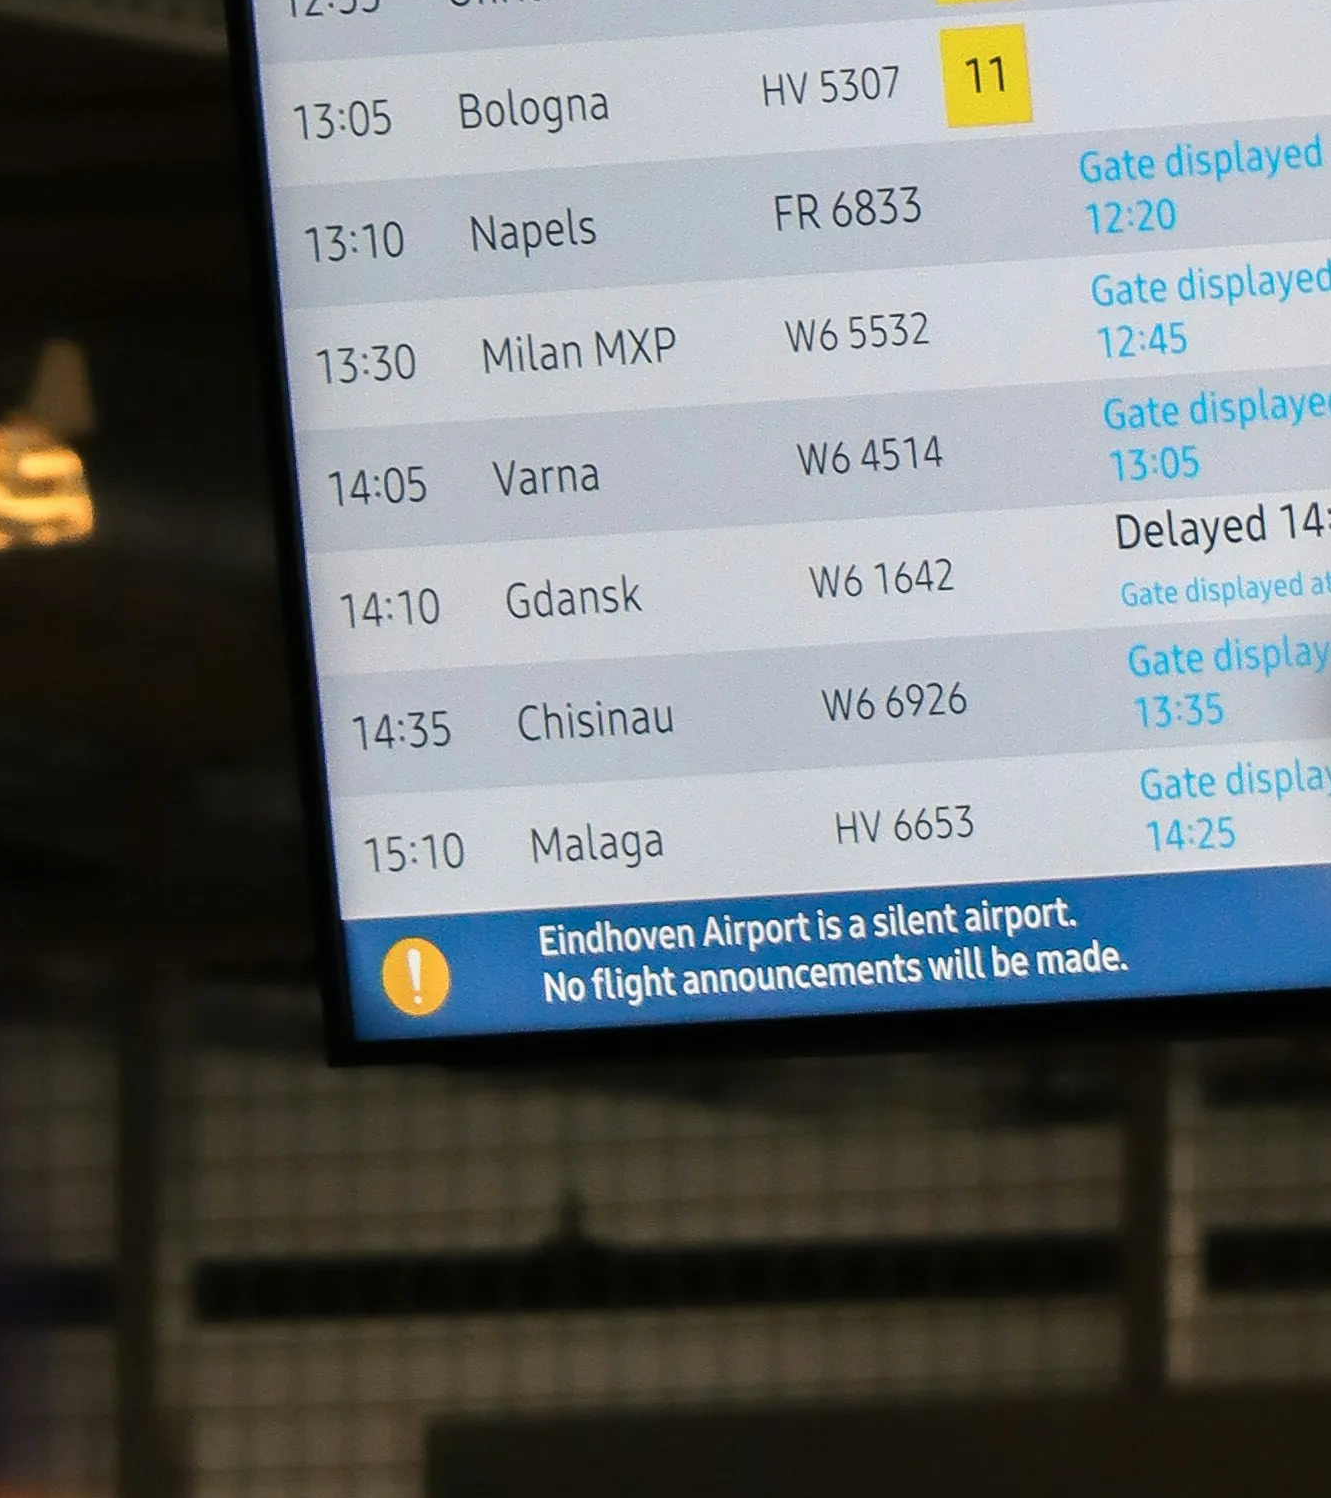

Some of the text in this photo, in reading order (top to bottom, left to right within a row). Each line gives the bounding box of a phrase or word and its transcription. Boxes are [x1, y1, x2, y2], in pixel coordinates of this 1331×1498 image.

[761, 64, 900, 108] HV 5307
[964, 54, 1006, 95] 11
[292, 97, 393, 141] 13:05
[457, 87, 610, 135] Bologna
[1078, 148, 1157, 185] Gate
[1164, 131, 1325, 184] displayed
[773, 184, 923, 233] FR 6833
[1084, 195, 1179, 236] 12:20
[303, 219, 406, 264] 13:10
[469, 206, 598, 259] Napels
[1090, 272, 1169, 309] Gate
[481, 325, 677, 375] Milan MXP
[783, 310, 931, 354] W6 5532
[1097, 320, 1189, 360] 12:45
[315, 342, 417, 385] 13:30
[1101, 395, 1181, 433] Gate
[795, 434, 944, 477] W6 4514
[1108, 443, 1202, 484] 13:05
[327, 464, 428, 508] 14:05
[491, 459, 601, 498] Varna
[1114, 502, 1268, 556] Delayed
[505, 573, 644, 621] Gdansk
[807, 557, 955, 600] W6 1642
[1120, 581, 1180, 608] Gate
[1184, 570, 1305, 607] displayed
[339, 586, 441, 630] 14:10
[517, 699, 675, 743] Chisinau
[820, 680, 969, 723] W6 6926
[1133, 690, 1226, 731] 13:35
[351, 709, 453, 752] 14:35
[835, 803, 975, 845] HV 6653
[1146, 814, 1238, 853] 14:25
[363, 831, 466, 874] 15:10
[530, 822, 665, 870] Malaga
[539, 897, 1077, 957] Eindhoven Airport is a silent airport.
[543, 939, 1129, 1007] No flight announcements will be made.
